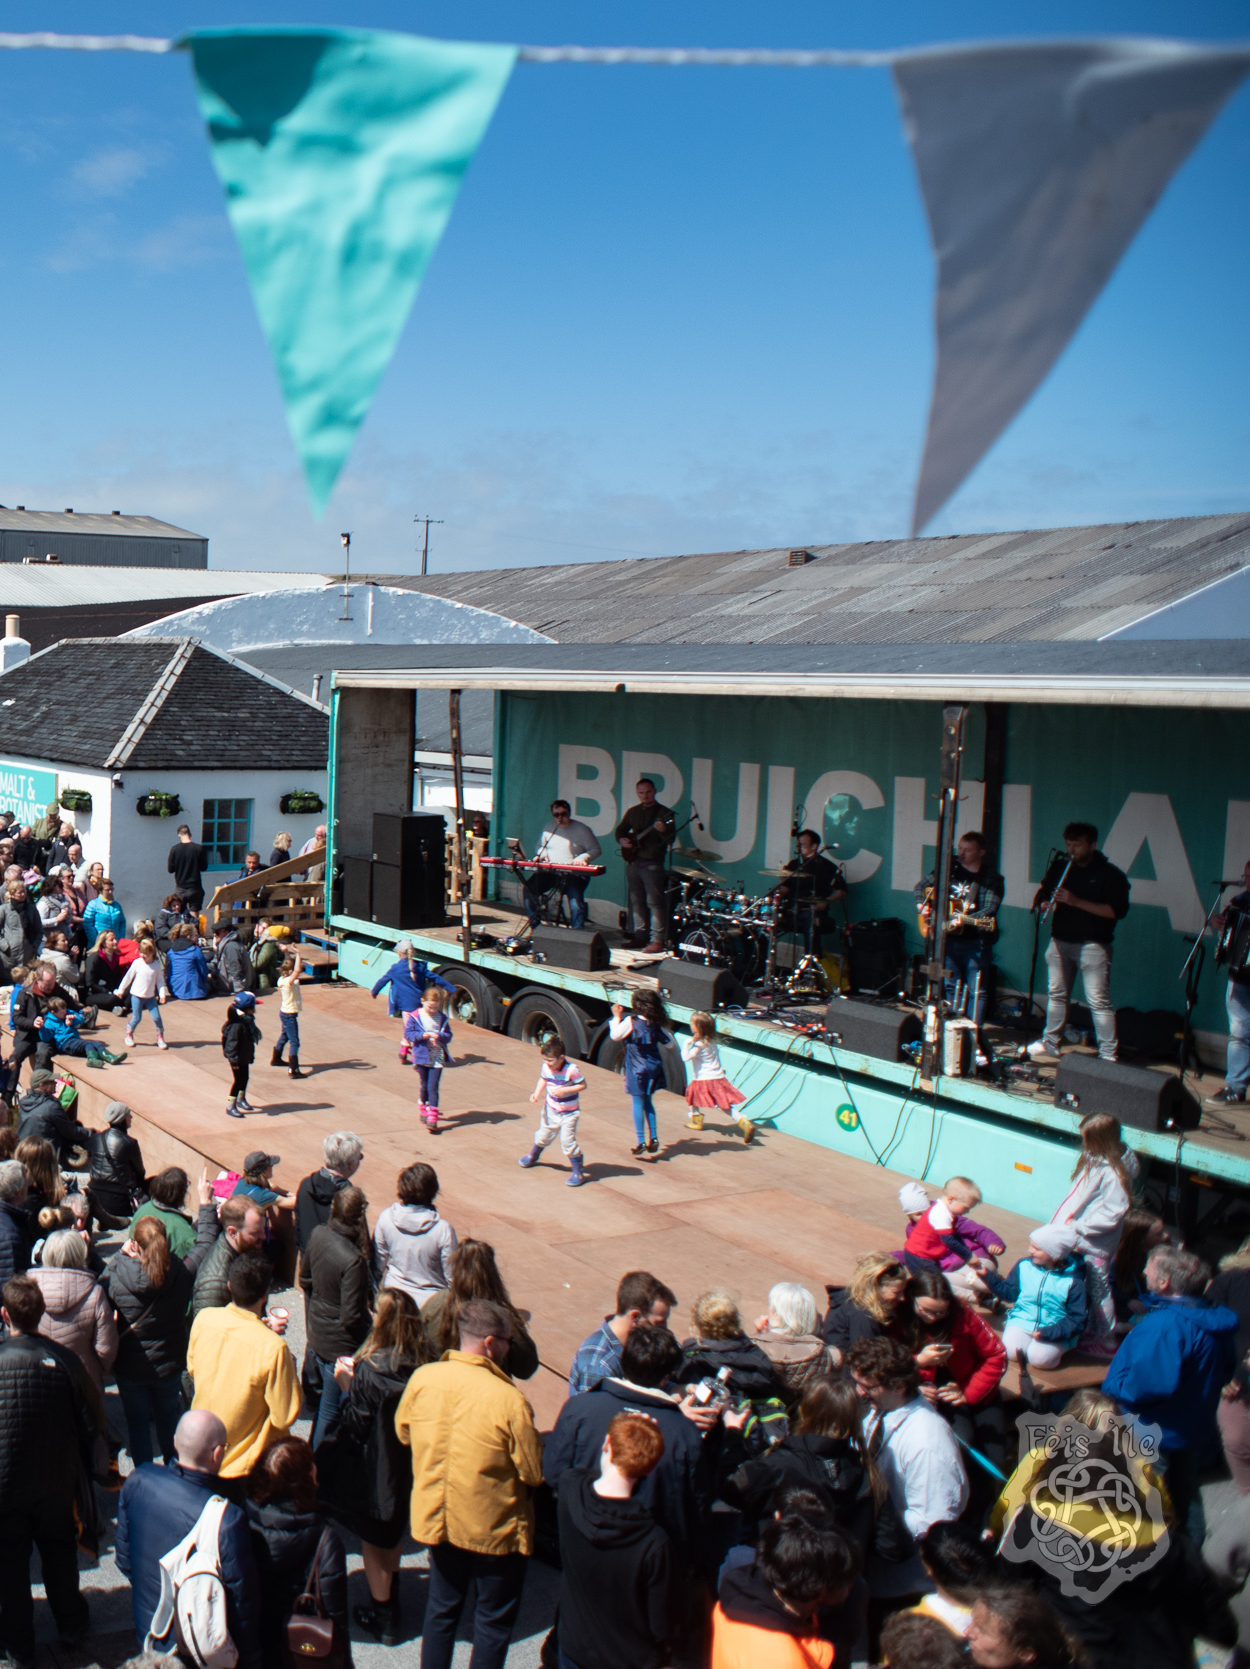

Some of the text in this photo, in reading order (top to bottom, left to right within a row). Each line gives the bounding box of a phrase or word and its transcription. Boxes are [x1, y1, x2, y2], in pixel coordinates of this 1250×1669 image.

[0, 771, 36, 801] MALT &
[557, 743, 1250, 936] BRUICHLA
[839, 1110, 857, 1127] 41
